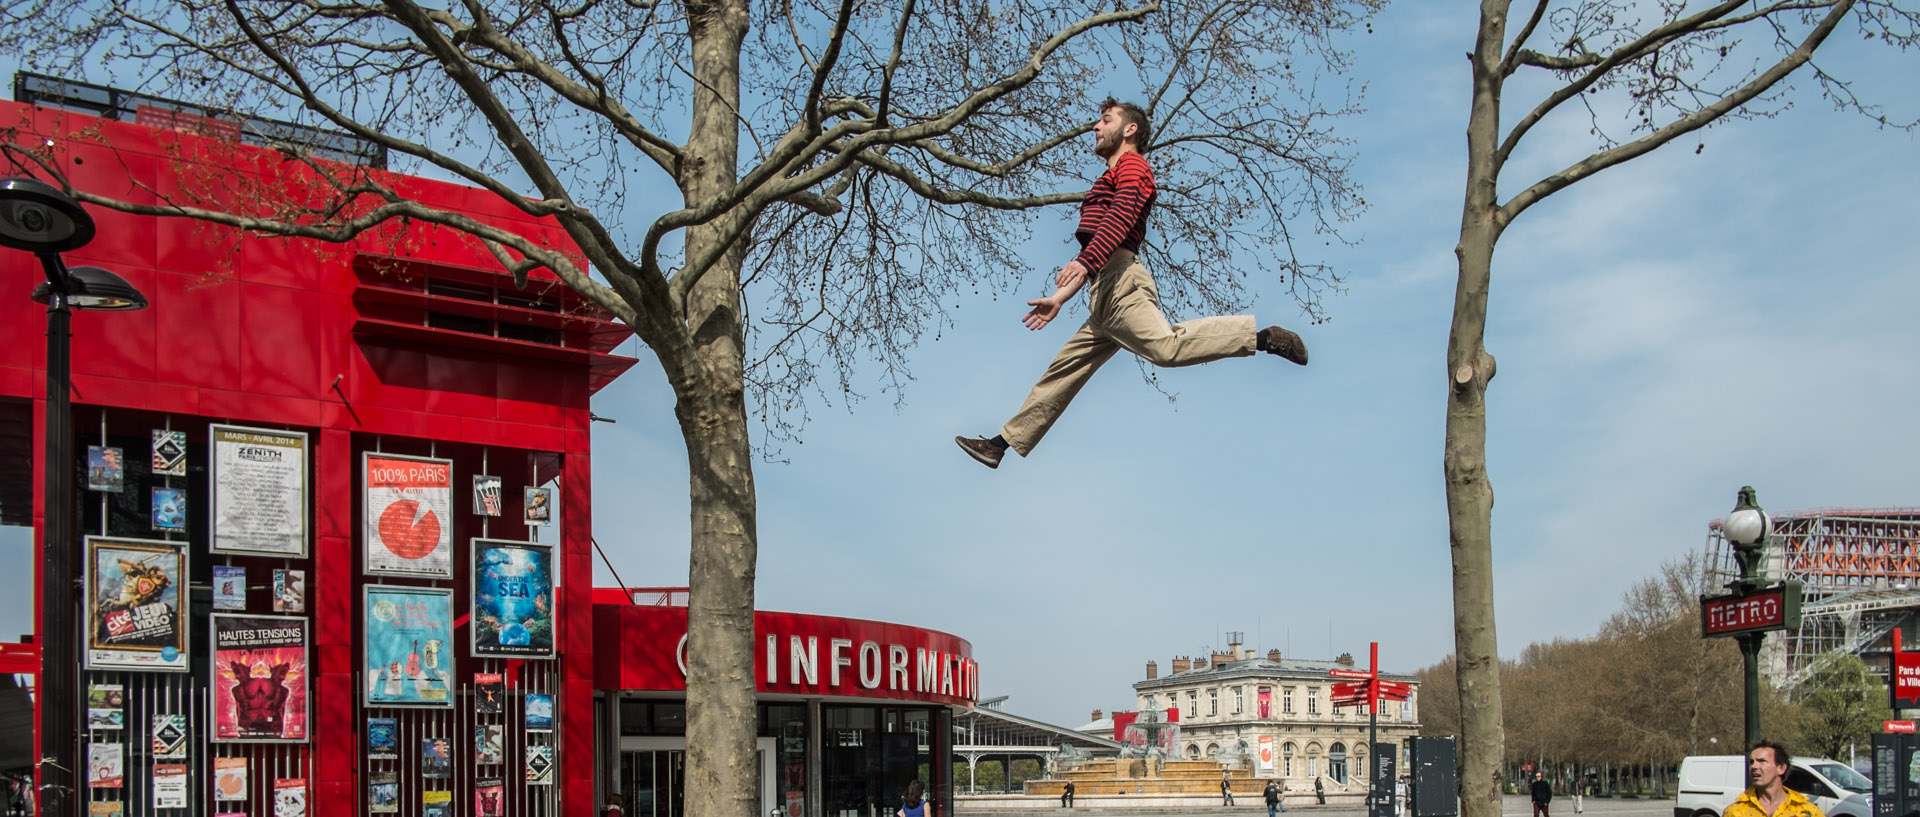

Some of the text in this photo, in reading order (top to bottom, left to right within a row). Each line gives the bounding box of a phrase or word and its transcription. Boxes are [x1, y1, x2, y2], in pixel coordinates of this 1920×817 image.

[224, 432, 247, 440] MARS
[253, 434, 274, 444] AVRIL
[276, 437, 295, 445] 2014
[238, 447, 282, 458] ZENITH
[371, 468, 447, 482] 100% PARIS
[498, 582, 530, 598] SEA
[1710, 598, 1777, 628] METRO
[107, 609, 131, 631] cité
[218, 628, 301, 640] HAUTES TENSIONS
[1898, 665, 1914, 675] Parc
[1898, 677, 1906, 686] la
